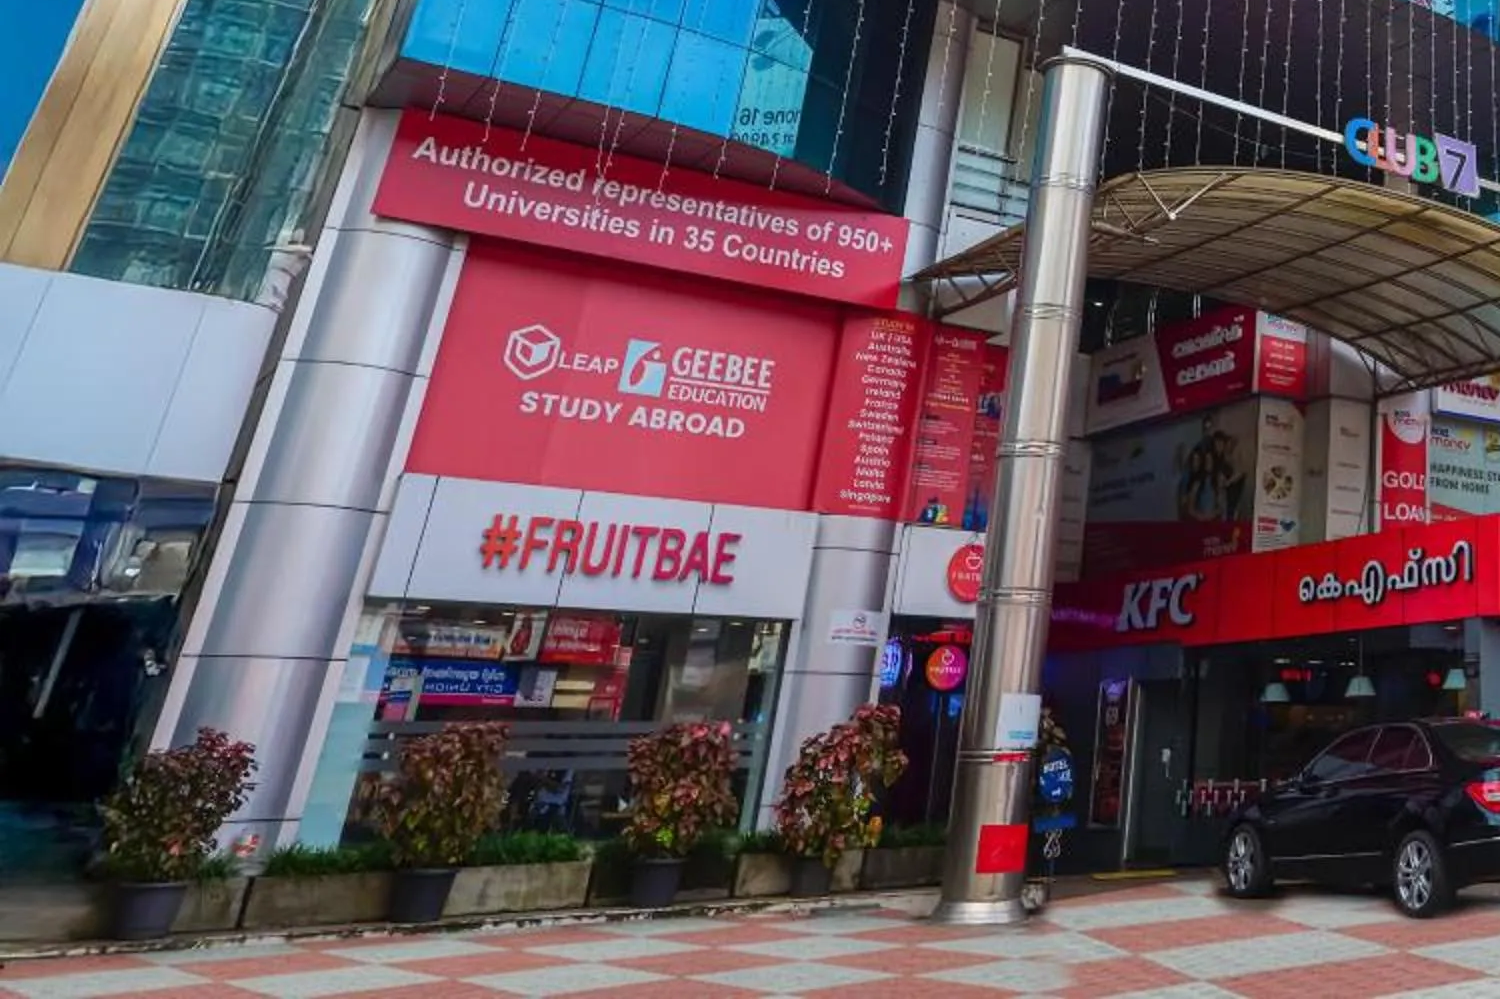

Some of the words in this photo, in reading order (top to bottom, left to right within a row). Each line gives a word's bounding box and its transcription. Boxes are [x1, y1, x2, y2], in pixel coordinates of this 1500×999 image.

[413, 136, 583, 195] Authorized
[593, 173, 800, 237] representatives
[807, 220, 836, 242] of
[838, 223, 893, 255] 950+
[464, 182, 640, 238] Universities
[649, 218, 674, 244] in
[684, 225, 714, 252] 35
[723, 239, 845, 278] Countries
[559, 350, 619, 375] LEAP
[671, 346, 775, 389] GEEBEE
[520, 390, 621, 424] STUDY
[628, 406, 745, 439] ABROAD
[668, 384, 768, 413] EDUCATION
[480, 513, 742, 586] #FRUITBAE
[1116, 574, 1198, 632] KFC
